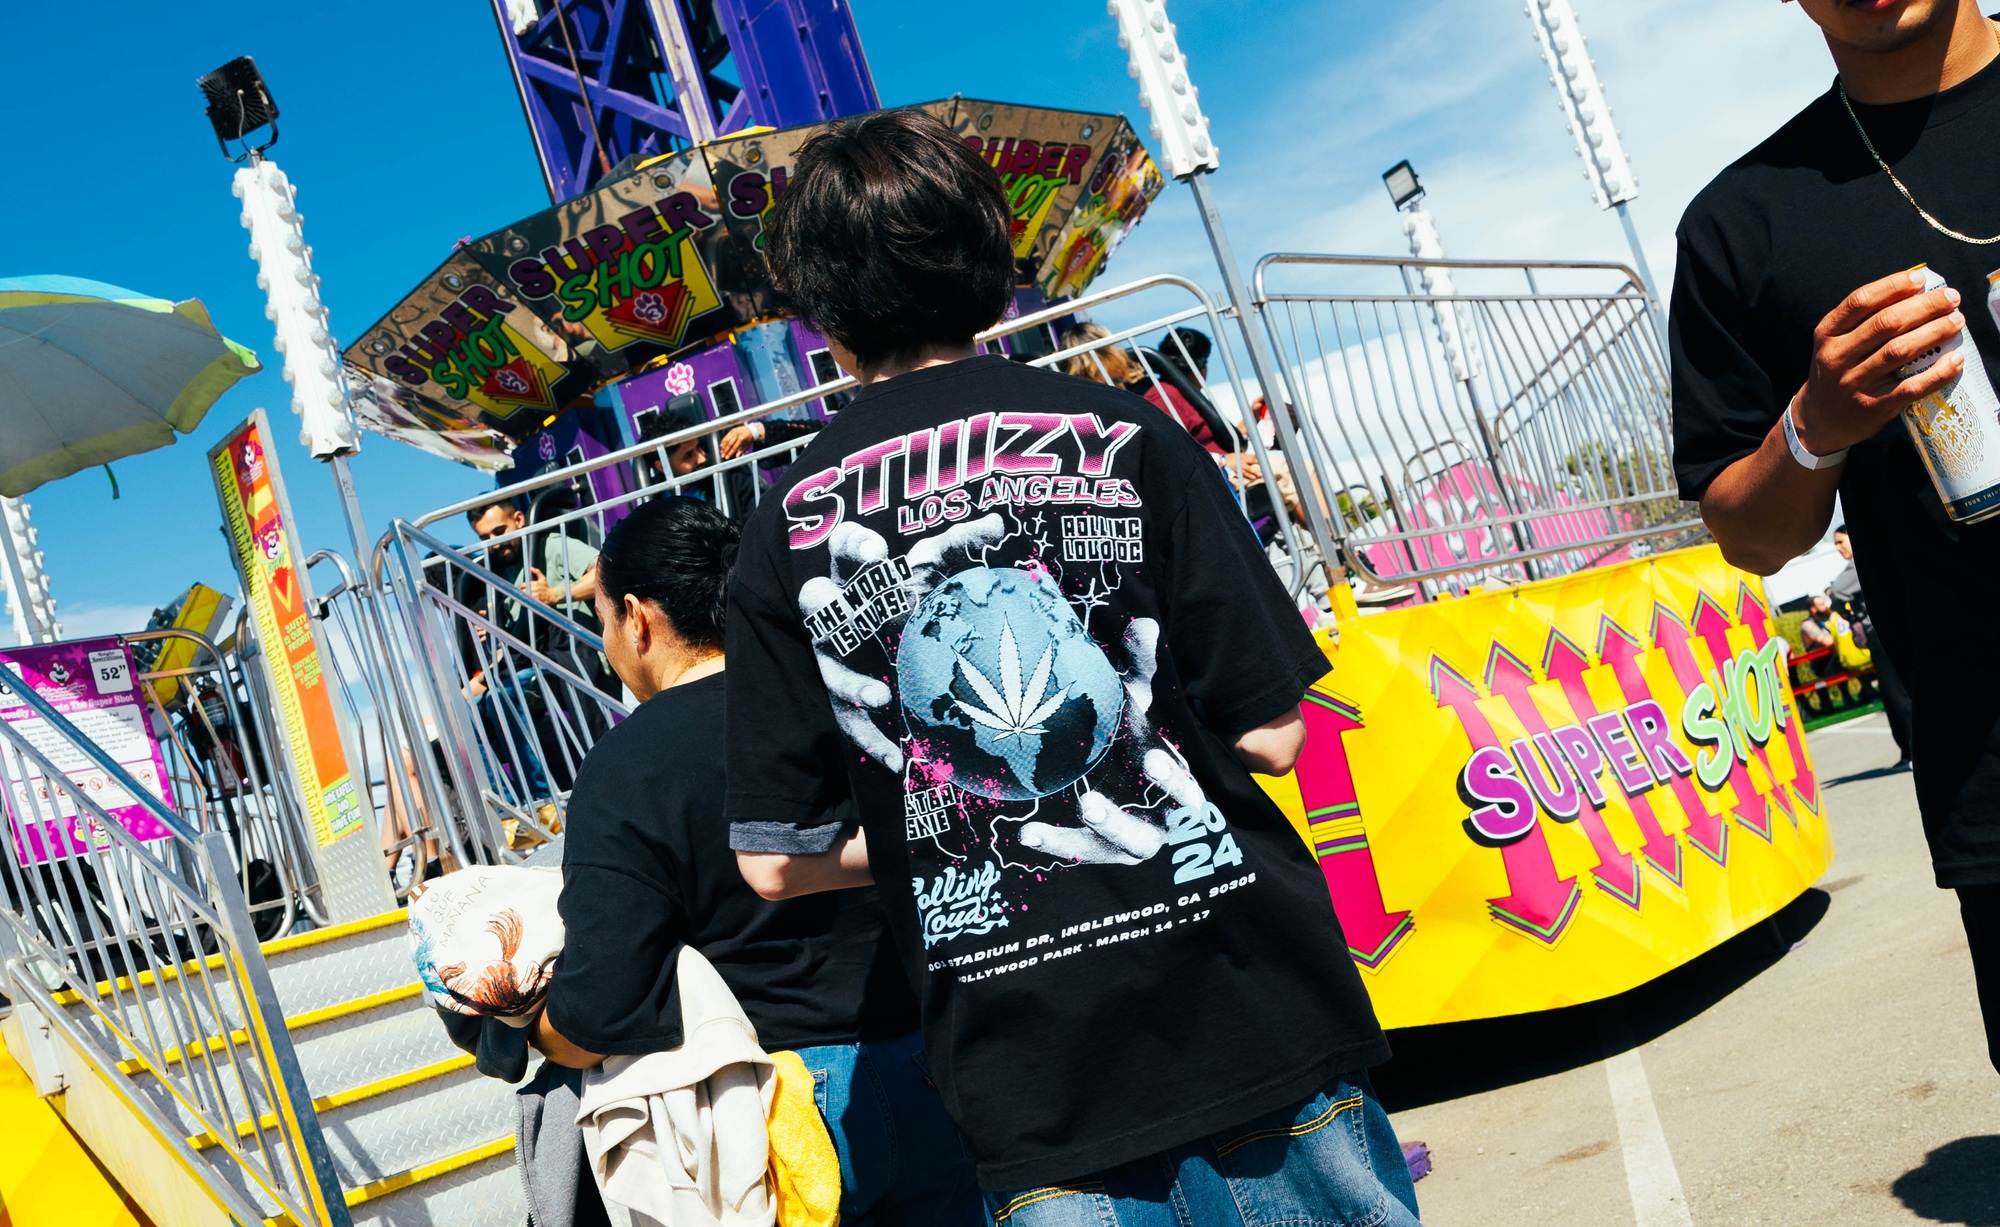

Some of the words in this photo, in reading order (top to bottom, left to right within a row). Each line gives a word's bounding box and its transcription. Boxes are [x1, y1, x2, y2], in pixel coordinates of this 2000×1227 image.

[1001, 172, 1067, 219] HOT
[509, 191, 716, 300] SUPER
[559, 226, 694, 323] SHOT
[384, 284, 517, 386] SUPER
[431, 313, 520, 400] SHOT
[783, 411, 1142, 550] STIIIZY
[898, 489, 972, 535] LOS
[978, 475, 1142, 510] ANGELES
[1061, 514, 1142, 539] ROLLING
[803, 598, 849, 641] THE
[841, 554, 914, 613] WORLD
[829, 622, 861, 657] IS
[114, 693, 134, 704] Shot
[1457, 699, 1694, 846] SUPER
[1682, 636, 1787, 791] SHOT
[1166, 801, 1227, 847] 20
[1171, 832, 1244, 885] 24
[948, 942, 1020, 968] STADIUM
[1026, 933, 1055, 949] DR,
[1061, 903, 1170, 938] INGLEWOOD,
[1177, 892, 1201, 907] CA
[1208, 872, 1257, 898] 90305
[958, 956, 1039, 983] OLLYWOOD
[1043, 943, 1082, 962] PARK
[1096, 927, 1150, 947] MARCH
[1155, 920, 1173, 934] 14
[1192, 909, 1211, 922] 17
